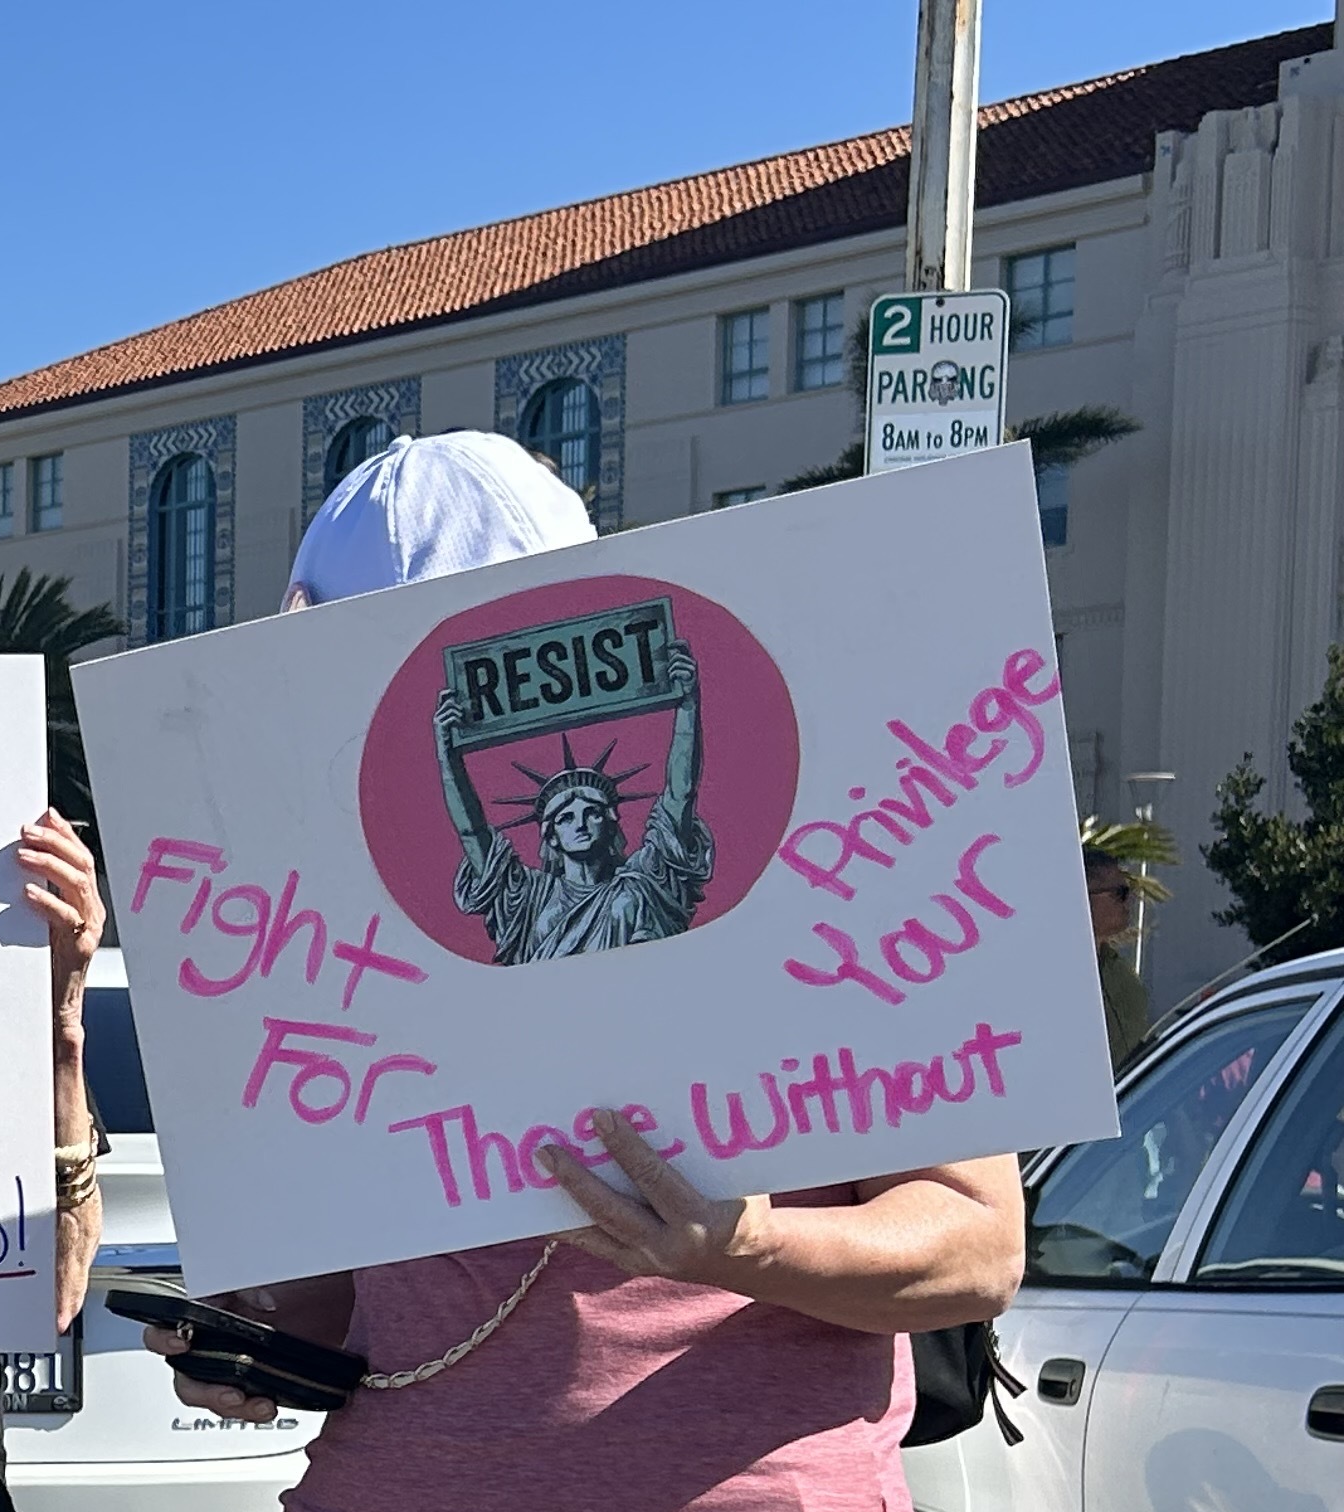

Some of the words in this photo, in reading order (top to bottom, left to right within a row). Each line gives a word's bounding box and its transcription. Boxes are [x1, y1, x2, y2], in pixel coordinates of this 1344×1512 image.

[882, 304, 912, 347] 2
[929, 311, 994, 344] HOUR
[877, 364, 995, 404] PARNG
[882, 422, 920, 451] 8AM
[926, 431, 943, 449] to
[950, 419, 988, 448] 8PM
[464, 619, 659, 722] RESIST
[778, 648, 1061, 901] Privilege
[129, 836, 430, 1012] Fight
[783, 832, 1016, 1005] Your
[241, 1016, 438, 1125] For
[388, 1104, 687, 1207] Those
[690, 1022, 1022, 1160] Without
